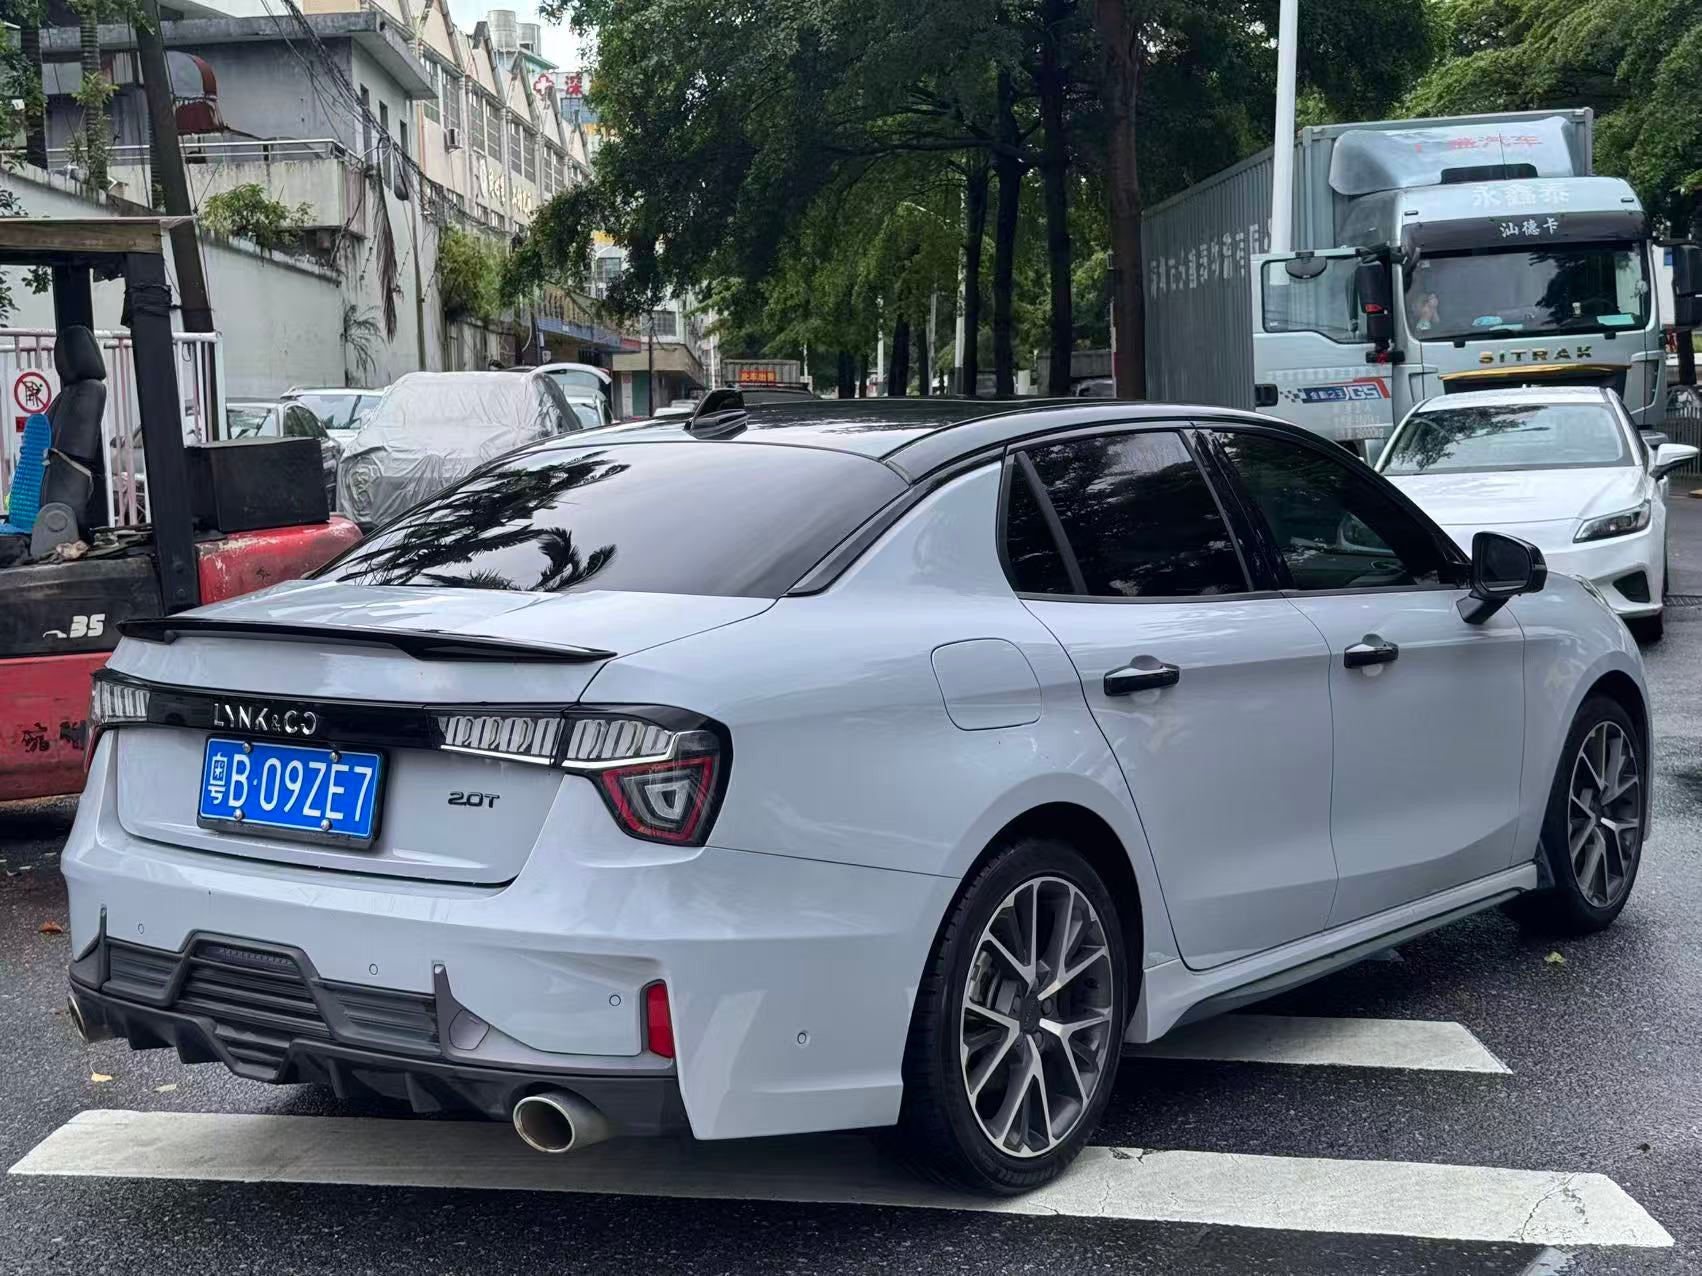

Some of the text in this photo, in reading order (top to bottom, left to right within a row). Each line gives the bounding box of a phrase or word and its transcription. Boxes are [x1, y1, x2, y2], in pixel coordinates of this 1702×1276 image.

[1500, 217, 1560, 238] 汕德卡
[1478, 345, 1593, 364] SITRAK
